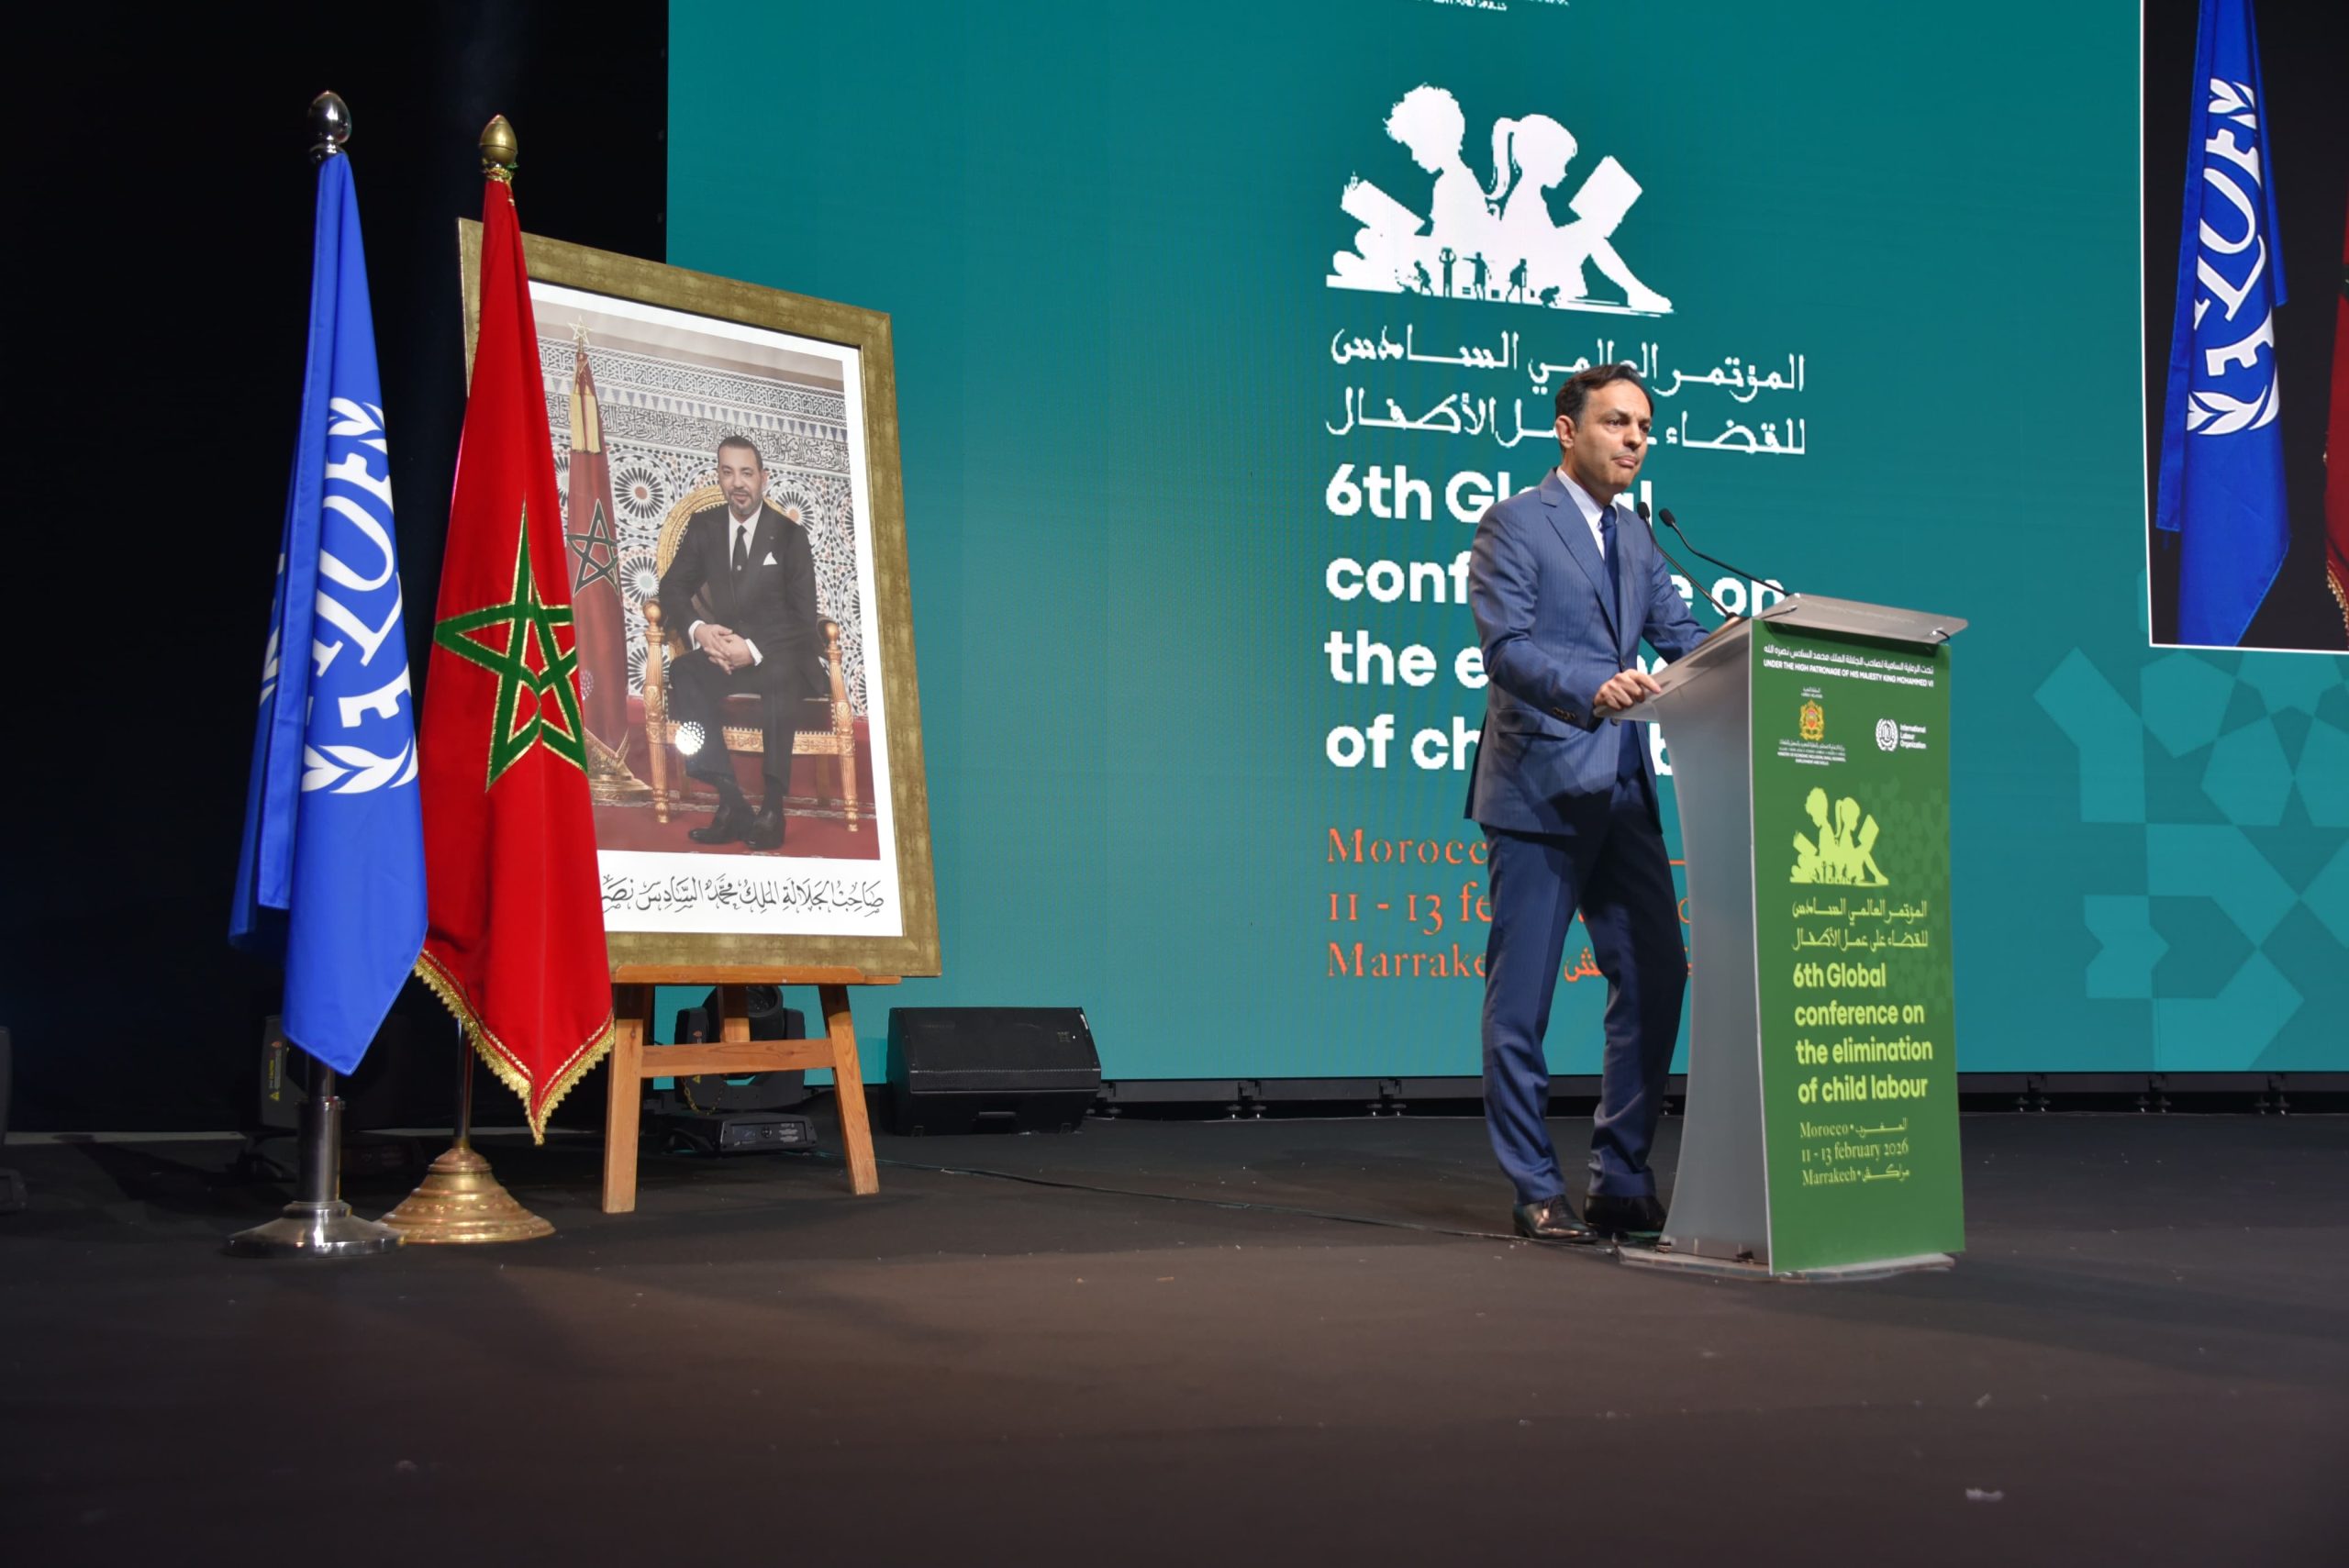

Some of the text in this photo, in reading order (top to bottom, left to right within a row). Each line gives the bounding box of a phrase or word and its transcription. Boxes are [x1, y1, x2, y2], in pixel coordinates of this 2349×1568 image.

[1653, 353, 1805, 403] المؤتمر
[1665, 410, 1806, 455] للقضاء
[1325, 462, 1432, 521] 6th
[1325, 629, 1437, 688] the
[1763, 659, 1783, 669] UNDER
[1783, 662, 1794, 670] THE
[1795, 662, 1809, 672] HIGH
[1809, 664, 1842, 676] PATRONAGE
[1841, 669, 1850, 677] OF
[1850, 670, 1859, 679] HIS
[1860, 672, 1883, 681] MAJESTY
[1883, 674, 1897, 683] KING
[1326, 714, 1395, 770] of
[1327, 827, 1487, 865] Morocc
[1327, 941, 1487, 978] Marrake
[1793, 962, 1887, 988] 6th Global
[1795, 1000, 1925, 1026] conference on
[1796, 1036, 1933, 1064] the elimination
[1798, 1073, 1929, 1104] of child labour
[1799, 1121, 1849, 1139] Morocco
[1834, 1142, 1881, 1163] february
[1884, 1138, 1909, 1159] 2026
[1801, 1168, 1856, 1185] Marrakech
